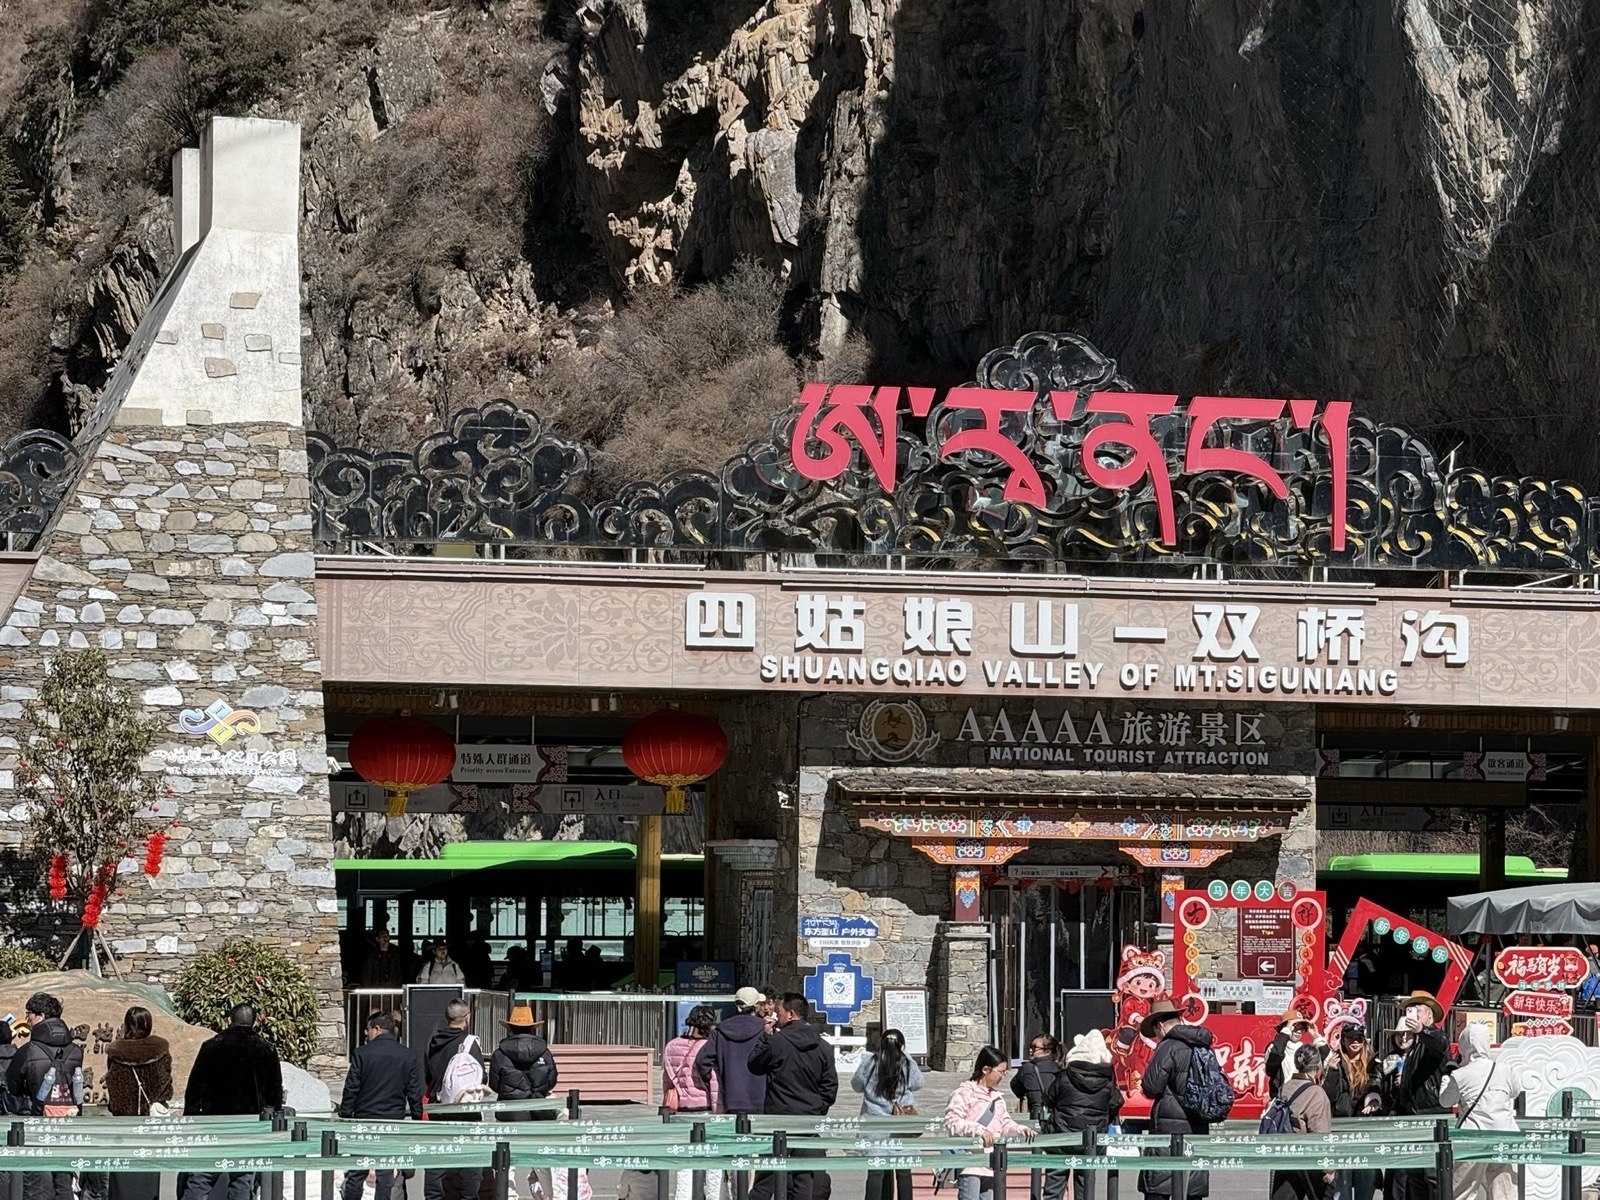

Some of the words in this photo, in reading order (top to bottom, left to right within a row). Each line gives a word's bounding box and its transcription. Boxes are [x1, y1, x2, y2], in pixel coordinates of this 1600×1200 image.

[760, 654, 967, 687] SHUANGQIAO
[983, 660, 1104, 690] VALLEY
[1119, 663, 1160, 691] OF
[1174, 664, 1399, 696] MT.SIGUNIANG
[460, 752, 532, 765] 特殊人群通道
[989, 746, 1075, 763] NATIONAL
[1083, 748, 1156, 764] TOURIST
[1163, 750, 1269, 766] ATTRACTION
[594, 787, 620, 801] 入口
[1359, 805, 1384, 817] 入口
[1213, 885, 1293, 898] 马年大吉
[1375, 918, 1447, 962] 新年快乐
[1513, 995, 1557, 1012] 新年快乐
